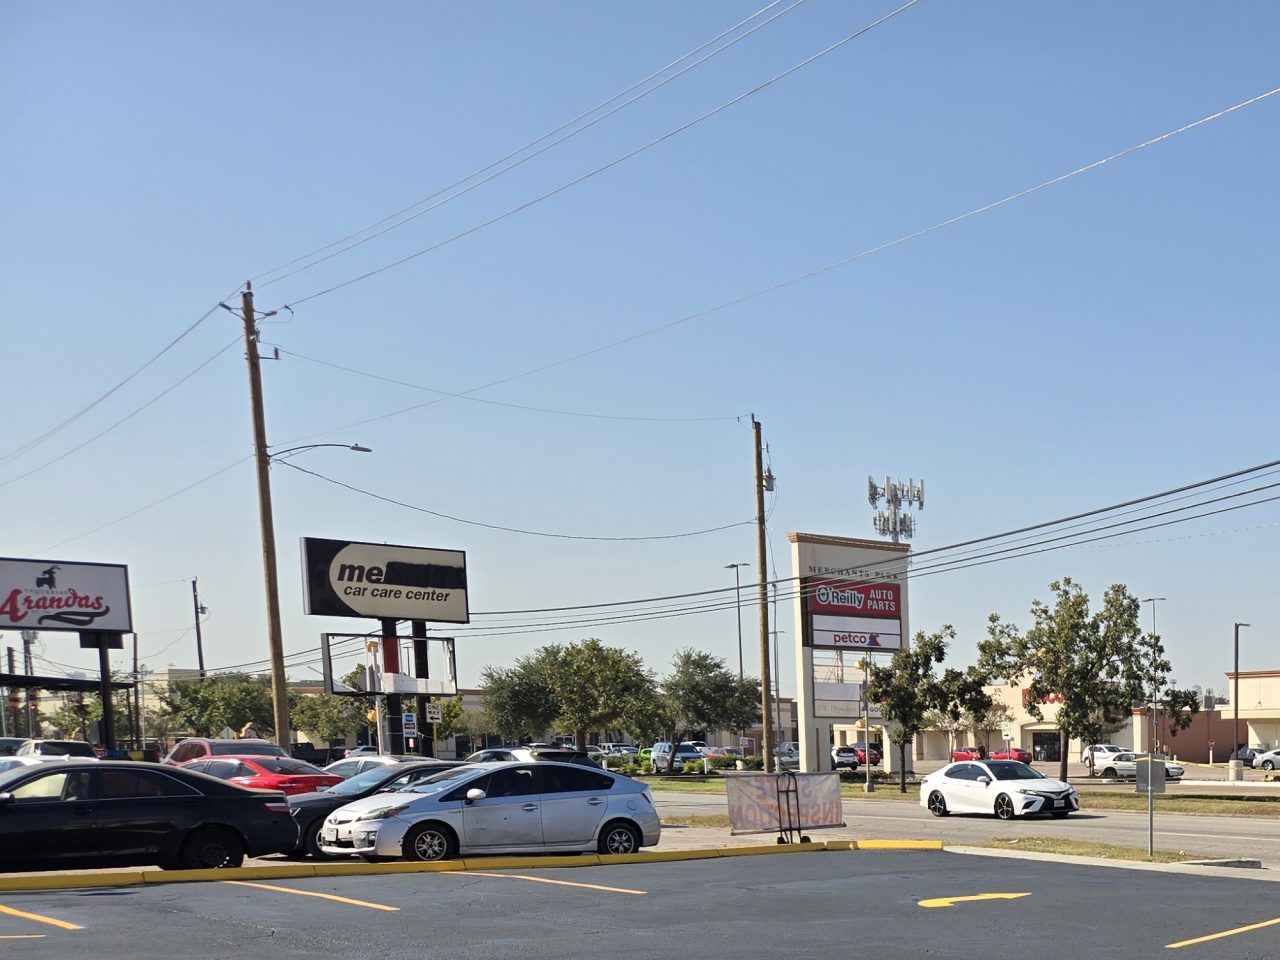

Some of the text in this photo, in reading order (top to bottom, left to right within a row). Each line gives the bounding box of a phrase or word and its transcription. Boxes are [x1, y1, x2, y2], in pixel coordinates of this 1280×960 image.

[808, 565, 869, 577] MERCHANTS
[344, 585, 450, 602] car care center
[817, 586, 863, 607] O'Reilly
[870, 590, 893, 600] AUTO
[0, 587, 104, 623] Arandas
[867, 600, 896, 611] PARTS
[833, 633, 867, 644] petco
